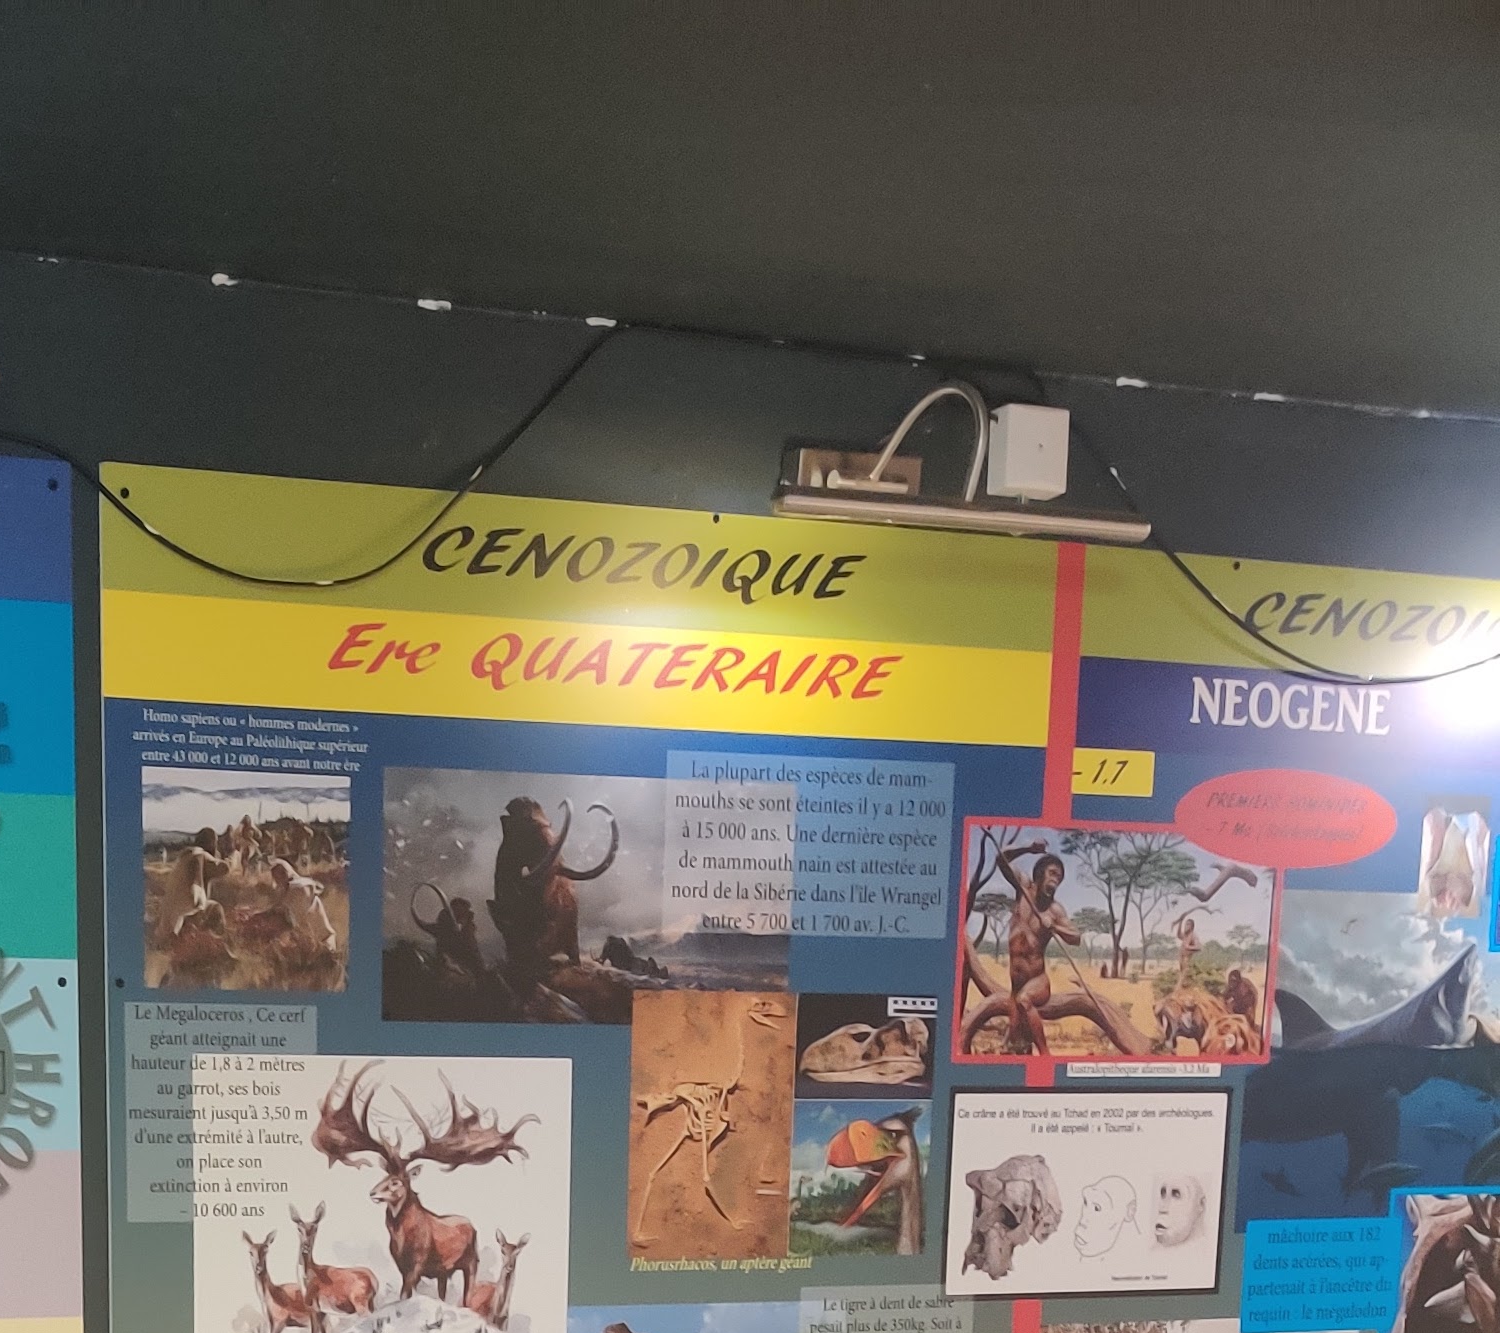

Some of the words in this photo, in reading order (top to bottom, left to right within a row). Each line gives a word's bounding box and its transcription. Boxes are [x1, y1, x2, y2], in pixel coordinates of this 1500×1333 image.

[422, 525, 868, 605] CENOZOIQUE
[327, 622, 441, 675] Ere
[470, 633, 905, 700] QUATERAIRE
[1190, 677, 1391, 736] NEOGENE
[691, 760, 709, 778] La
[714, 761, 772, 785] plupart
[776, 763, 802, 782] des
[806, 768, 862, 789] espèces
[866, 768, 884, 786] de
[889, 774, 932, 788] mam-
[682, 820, 690, 838] à
[696, 822, 715, 839] 15
[718, 823, 746, 840] 000
[750, 829, 780, 841] ans.
[786, 825, 816, 842] Une
[821, 826, 885, 844] dernière
[889, 830, 937, 850] espèce
[679, 850, 698, 868] de
[702, 853, 793, 871] mammouth
[799, 858, 830, 873] nain
[836, 861, 856, 873] est
[860, 858, 916, 875] attestée
[920, 862, 937, 876] au
[671, 880, 708, 899] nord
[713, 881, 732, 899] de
[736, 882, 749, 900] la
[754, 883, 806, 901] Sibérie
[810, 884, 846, 902] dans
[880, 887, 941, 910] Wrangel
[135, 1005, 151, 1020] Le
[156, 1006, 244, 1025] Megaloceros
[256, 1008, 275, 1022] Ce
[279, 1008, 307, 1022] cerf
[150, 1033, 187, 1049] géant
[192, 1035, 256, 1050] atteignait
[261, 1037, 287, 1047] une
[131, 1054, 186, 1070] hauteur
[189, 1055, 206, 1070] de
[212, 1057, 231, 1073] 1,8
[234, 1056, 242, 1070] à
[247, 1058, 254, 1071] 2
[259, 1057, 305, 1071] mètres
[157, 1083, 173, 1095] au
[177, 1083, 224, 1099] garrot,
[228, 1085, 248, 1095] ses
[252, 1080, 281, 1095] bois
[721, 1259, 737, 1270] un
[740, 1257, 776, 1273] aptère
[778, 1256, 812, 1273] géant
[823, 1297, 838, 1312] Le
[841, 1298, 867, 1315] tigre
[869, 1296, 877, 1311] à
[880, 1296, 905, 1311] dent
[908, 1296, 922, 1310] de
[925, 1295, 955, 1309] sabre
